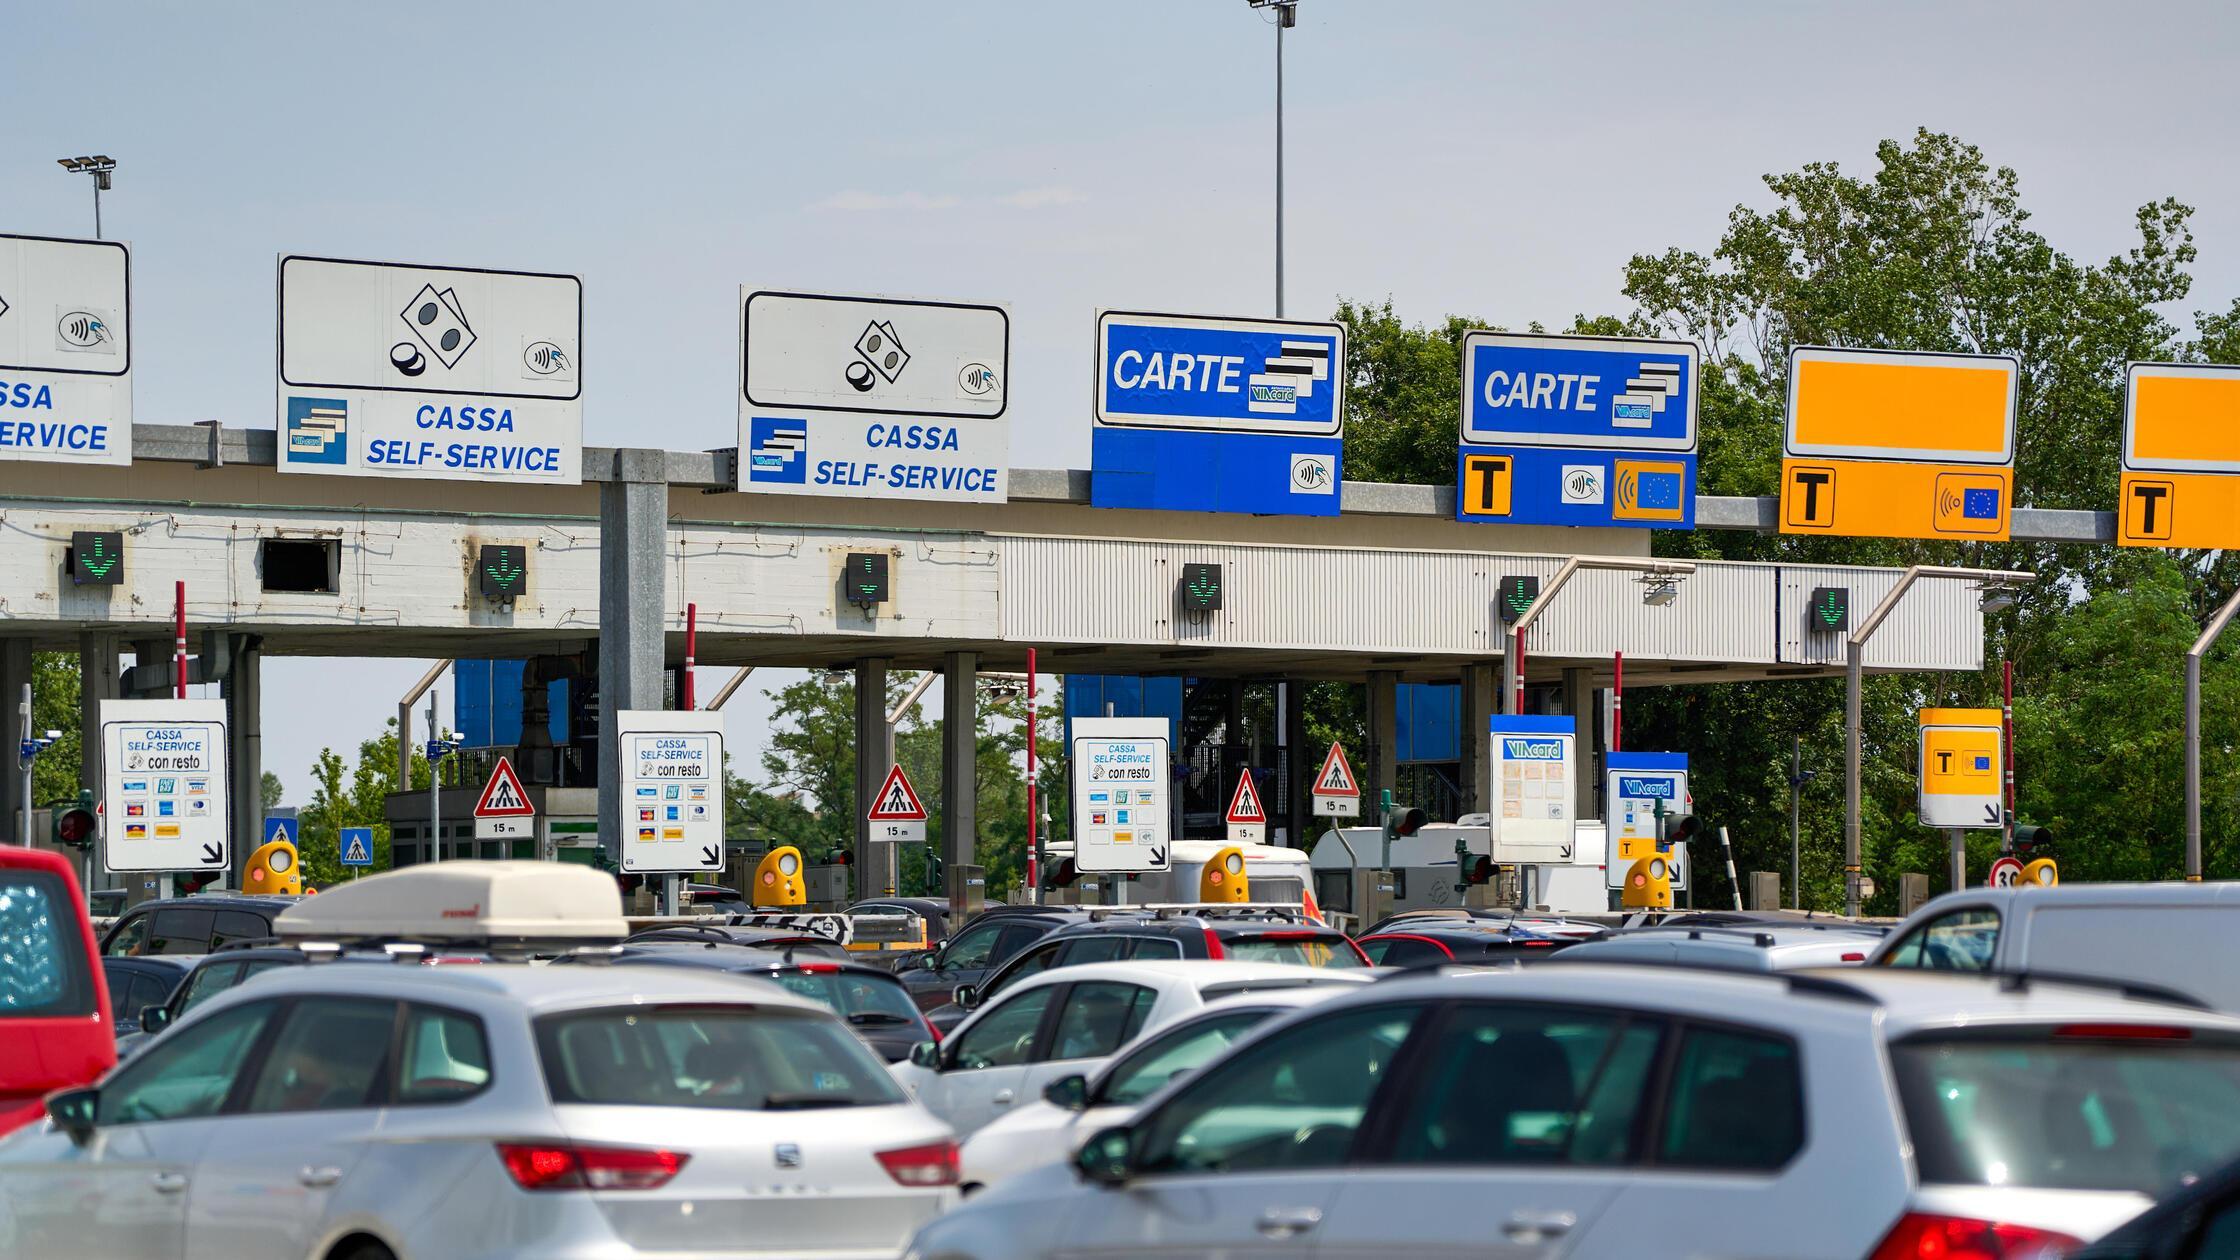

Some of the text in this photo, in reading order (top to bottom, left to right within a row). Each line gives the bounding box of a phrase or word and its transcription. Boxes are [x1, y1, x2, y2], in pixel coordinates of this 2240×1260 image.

[1113, 350, 1244, 393] CARTE
[1484, 370, 1601, 412] CARTE
[415, 405, 514, 433] CASSA
[0, 421, 108, 450] ERVICE
[866, 424, 959, 451] CASSA
[367, 439, 561, 472] SELF-SERVICE
[814, 460, 998, 492] SELF-SERVICE
[1471, 460, 1506, 510] T
[1796, 472, 1829, 521] T
[2134, 486, 2167, 534] T
[146, 730, 182, 740] CASSA
[127, 741, 202, 752] SELF-SERVICE
[656, 739, 687, 749] CASSA
[1108, 744, 1137, 753] CASSA
[1506, 740, 1561, 759] VIAcard
[148, 754, 200, 769] con resto
[640, 750, 703, 760] SELF-SERVICE
[1093, 754, 1151, 763] SELF-SERVICE
[1936, 752, 1952, 773] T
[657, 763, 701, 776] con resto
[1108, 766, 1150, 779] con resto
[1624, 780, 1671, 796] VIAcard
[1326, 801, 1347, 812] 15 m
[493, 823, 505, 833] 15
[887, 827, 898, 836] 15
[1239, 829, 1247, 838] 15
[1623, 843, 1631, 854] T
